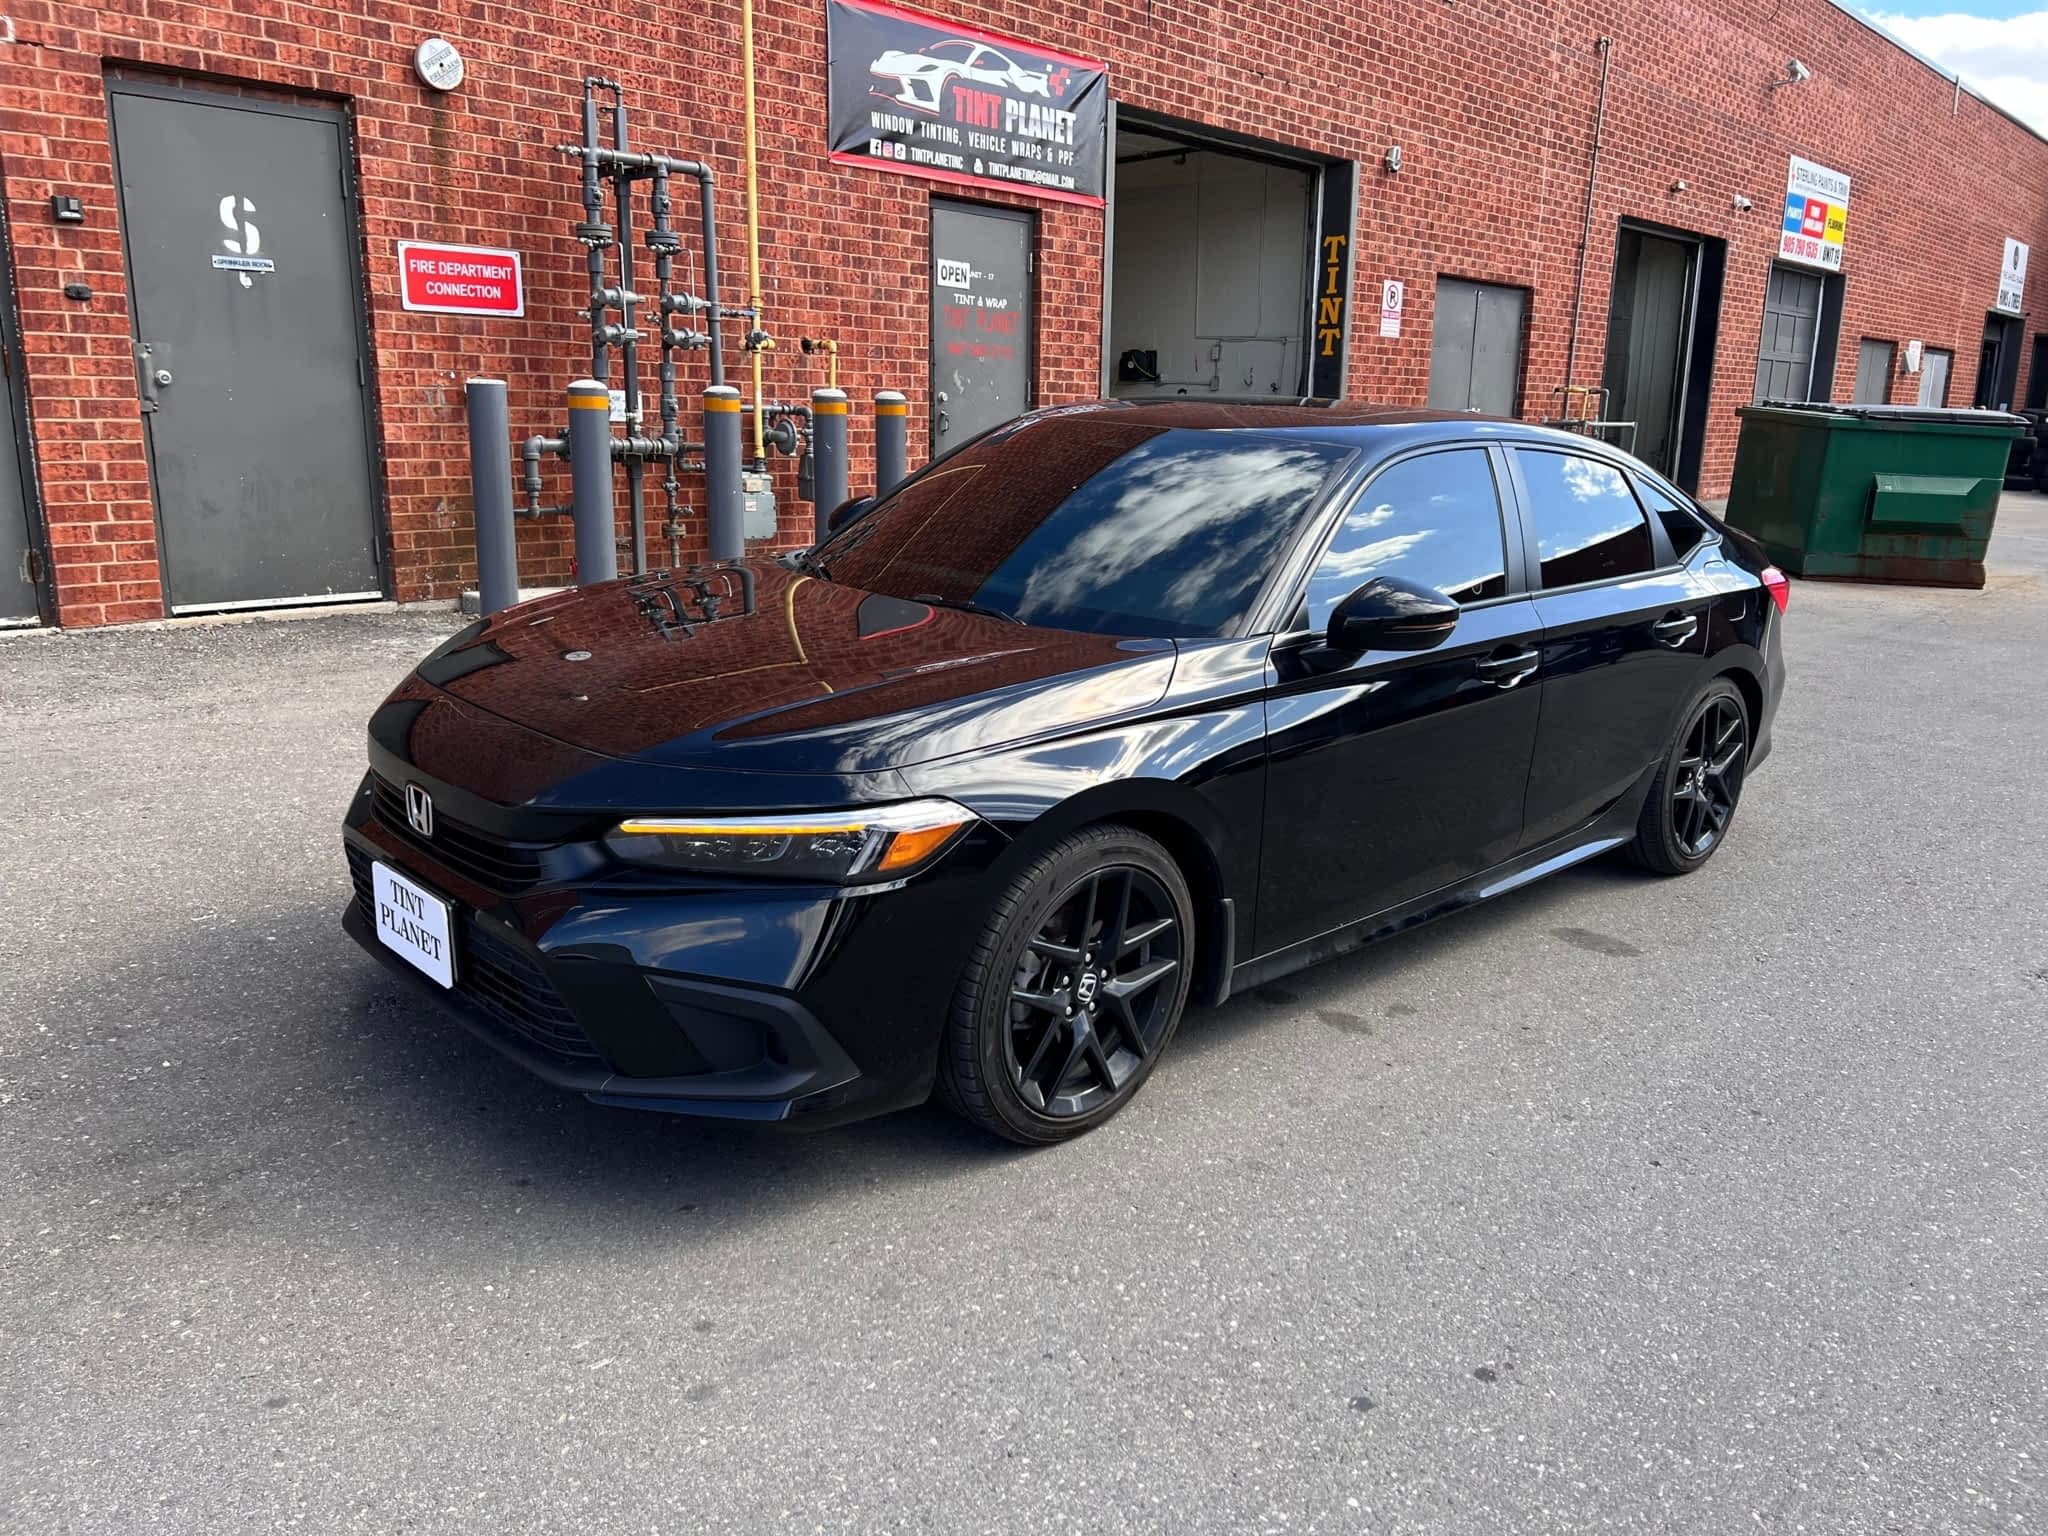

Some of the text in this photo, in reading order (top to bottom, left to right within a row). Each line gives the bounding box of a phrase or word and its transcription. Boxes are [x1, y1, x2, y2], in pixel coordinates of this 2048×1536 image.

[953, 86, 1077, 145] TINT PLANET
[871, 111, 1074, 166] WINDOW TINTING, VEHICLE WRAPS & PPF
[911, 147, 963, 169] TINTPLANETINC
[988, 161, 1075, 189] TINTPLANETINC@GMAIL.COM
[219, 195, 260, 255] S
[409, 259, 512, 280] FIRE DEPARTMENT
[940, 265, 968, 282] OPEN
[426, 281, 501, 298] CONNECTION
[954, 293, 1007, 310] TINT & WRAP
[1318, 235, 1346, 356] TINT
[390, 879, 424, 921] TINT
[380, 902, 442, 961] PLANET
